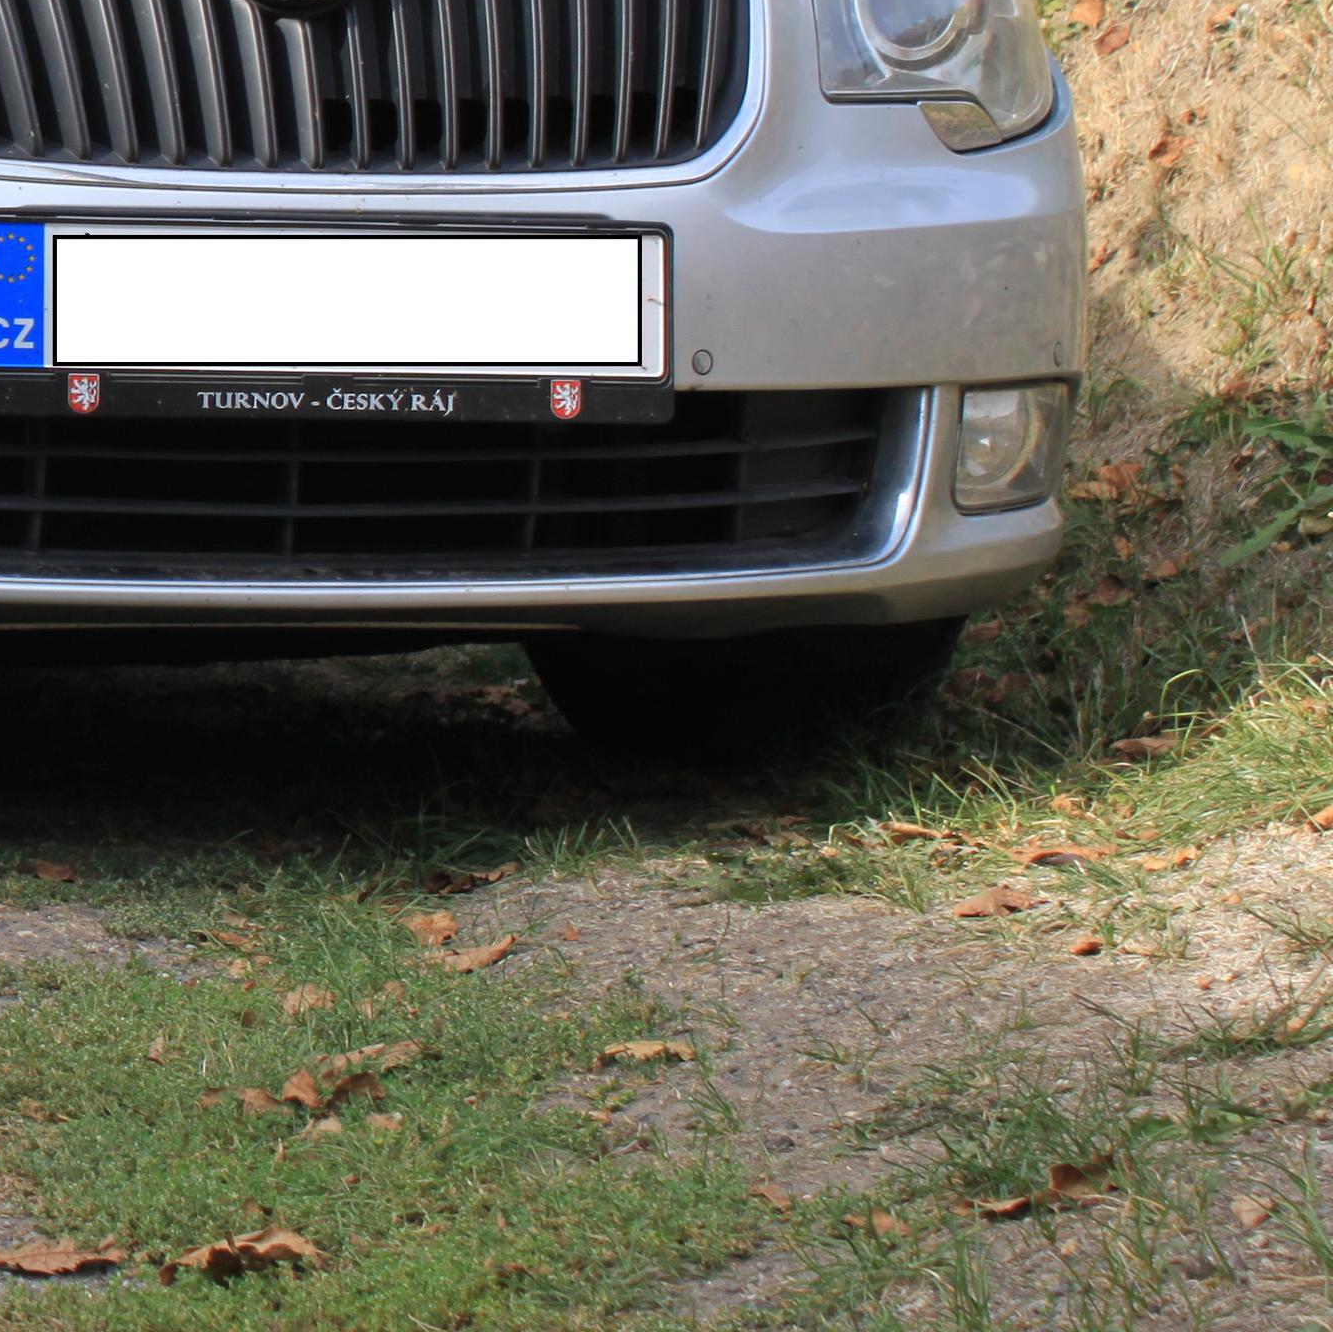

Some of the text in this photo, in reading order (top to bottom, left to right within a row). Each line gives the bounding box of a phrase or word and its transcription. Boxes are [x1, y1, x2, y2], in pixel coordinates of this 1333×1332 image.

[196, 391, 306, 410] TURNOV
[325, 387, 404, 411] ČESKÝ
[409, 388, 457, 416] RÁJ
